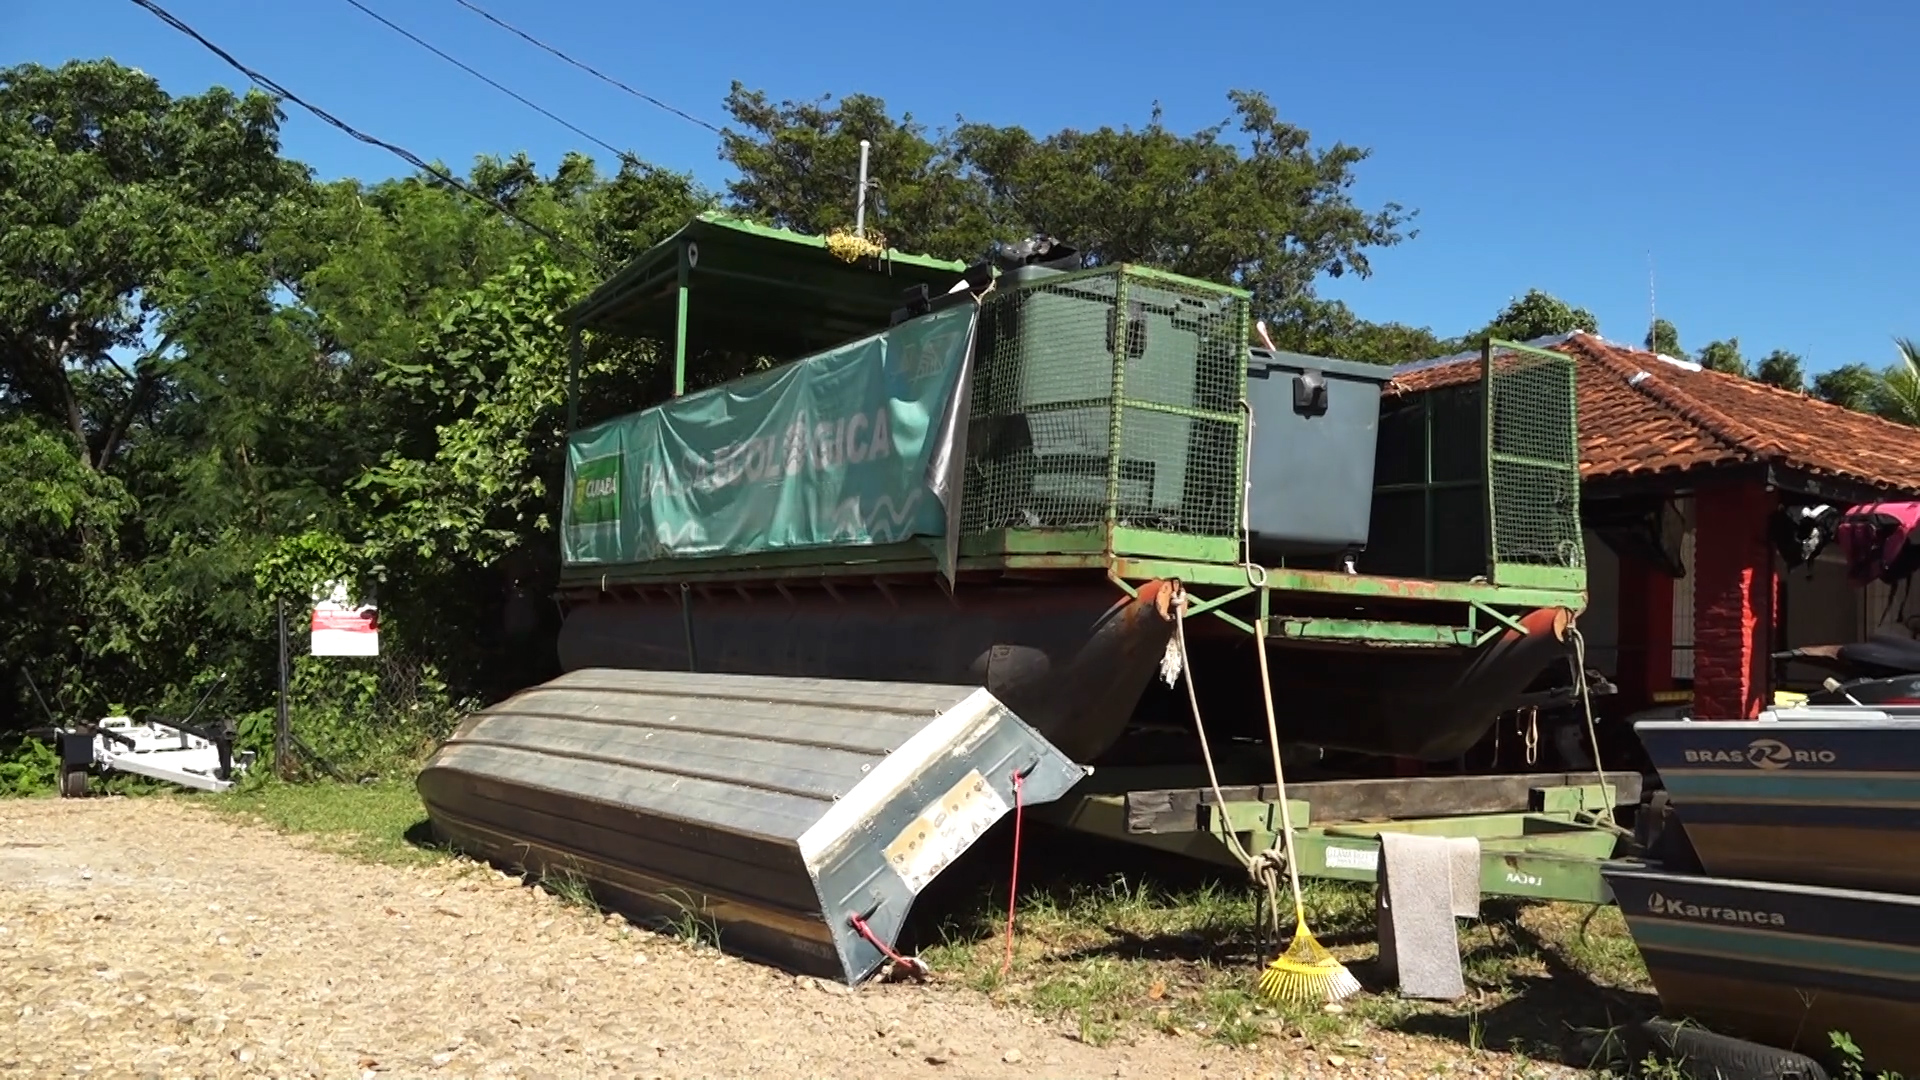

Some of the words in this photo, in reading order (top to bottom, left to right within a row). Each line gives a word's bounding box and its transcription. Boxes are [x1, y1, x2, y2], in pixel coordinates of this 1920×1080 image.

[1684, 749, 1744, 763] BRAS
[1794, 749, 1837, 763] RIO
[1667, 898, 1786, 926] Karranca
